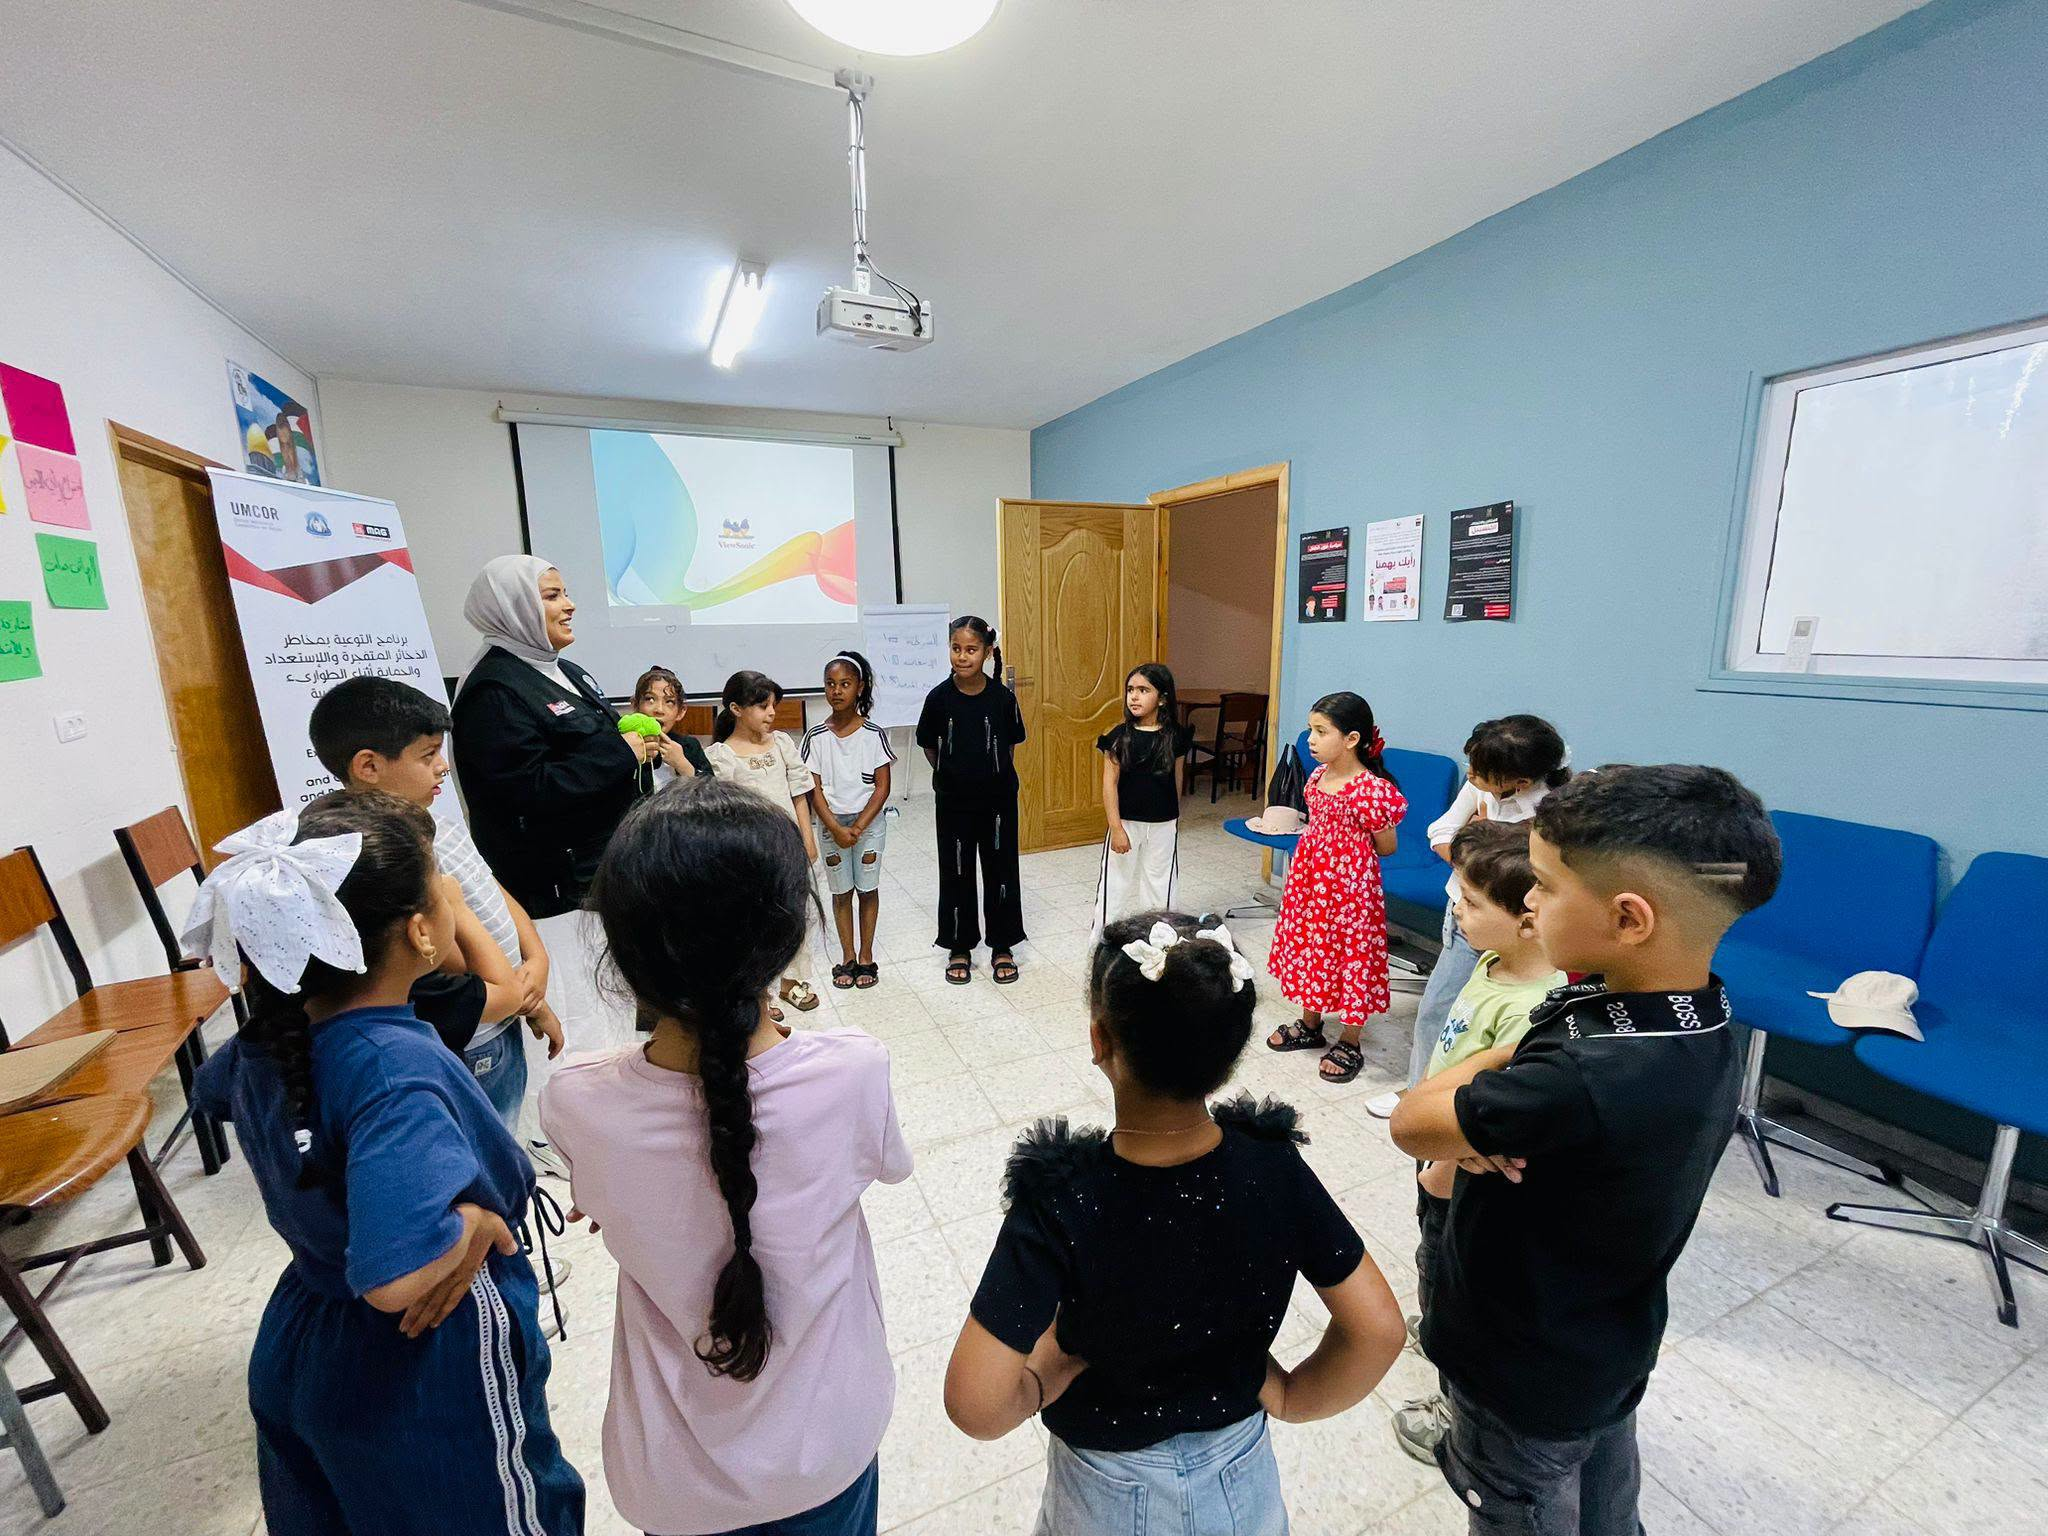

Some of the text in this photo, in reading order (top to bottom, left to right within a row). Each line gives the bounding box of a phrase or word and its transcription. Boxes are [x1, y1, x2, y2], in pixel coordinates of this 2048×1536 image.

[230, 501, 280, 521] UMCOR
[366, 526, 388, 537] MAG
[1375, 559, 1396, 570] يهمنا
[283, 633, 408, 648] برنامج التوعية بمخاطر
[342, 650, 392, 664] المتفجرة
[378, 666, 421, 678] والحماية
[306, 775, 330, 787] and
[1667, 995, 1702, 1029] BOSS
